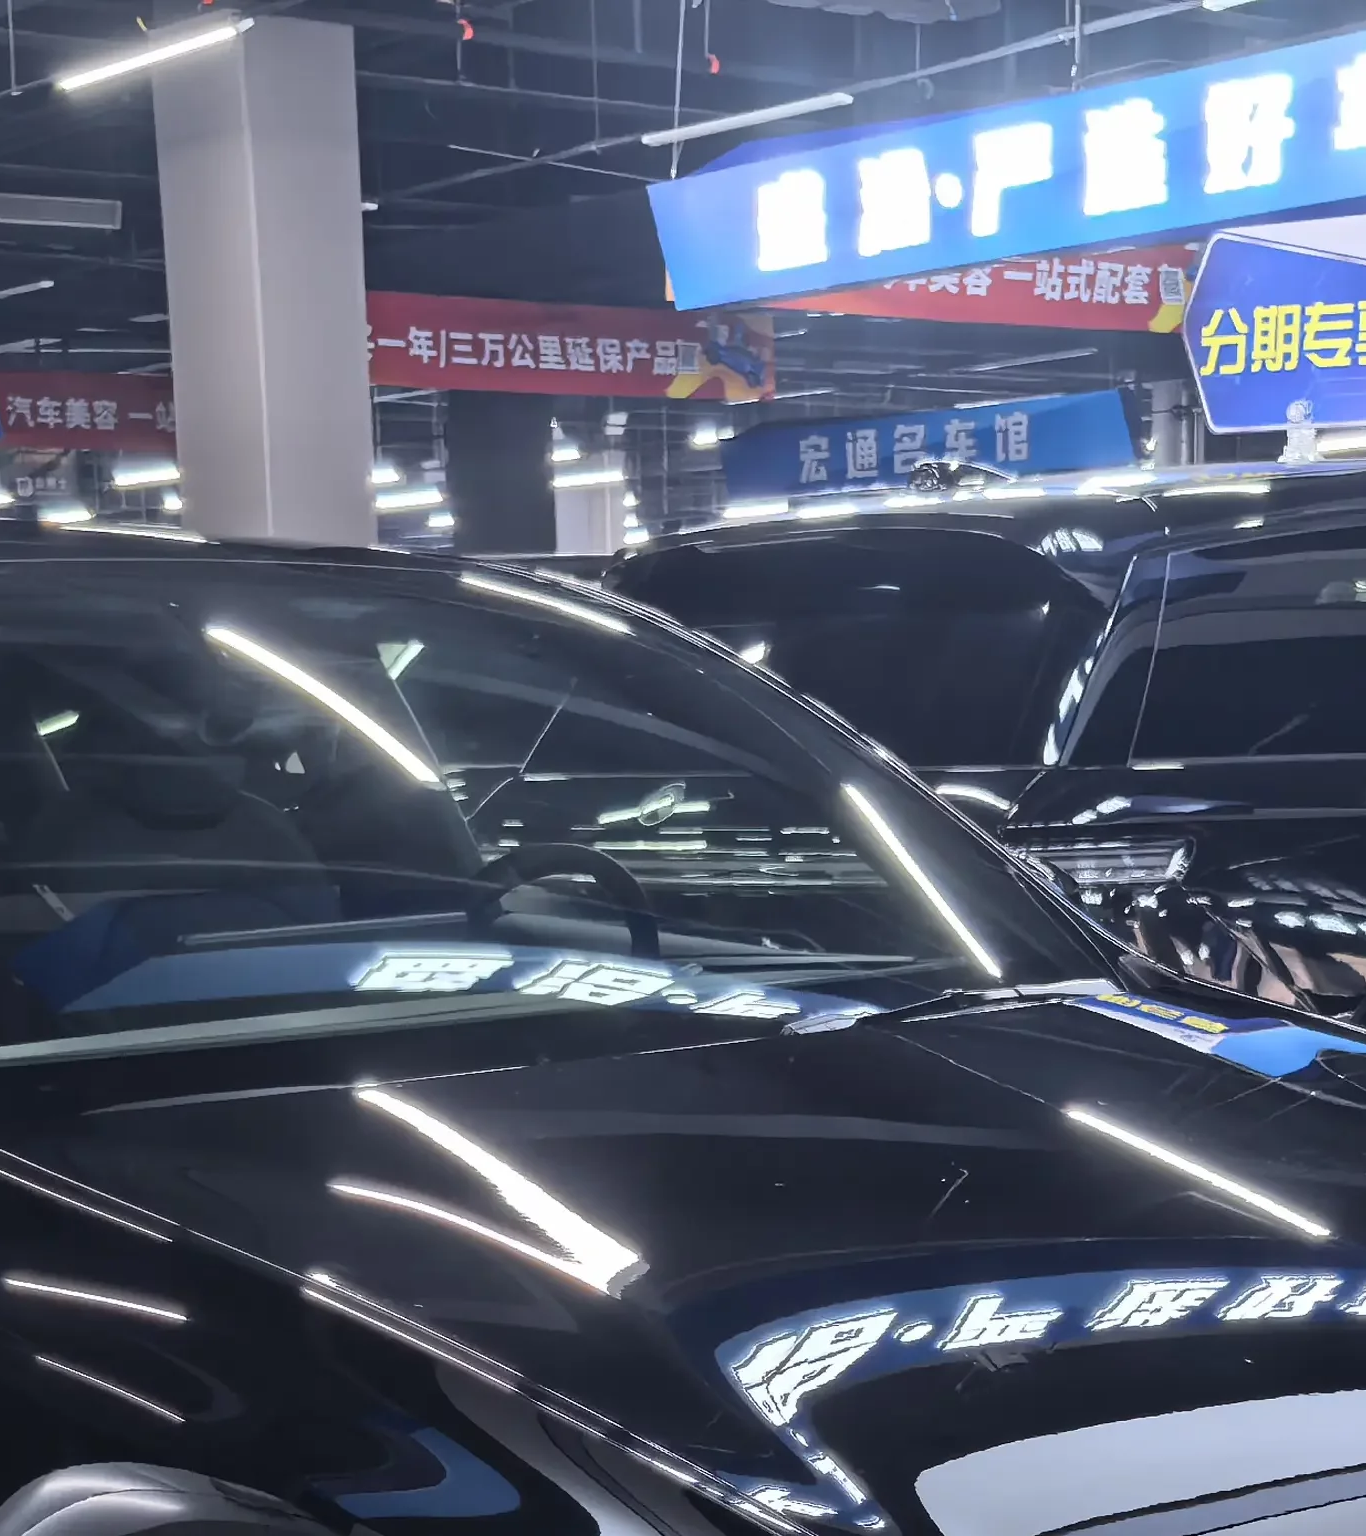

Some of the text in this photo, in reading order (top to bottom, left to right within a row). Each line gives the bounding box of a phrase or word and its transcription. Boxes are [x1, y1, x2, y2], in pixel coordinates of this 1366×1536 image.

[1003, 258, 1150, 304] 一站式配套
[6, 396, 118, 430] 汽车美容
[799, 411, 1030, 484] 宏通名车馆
